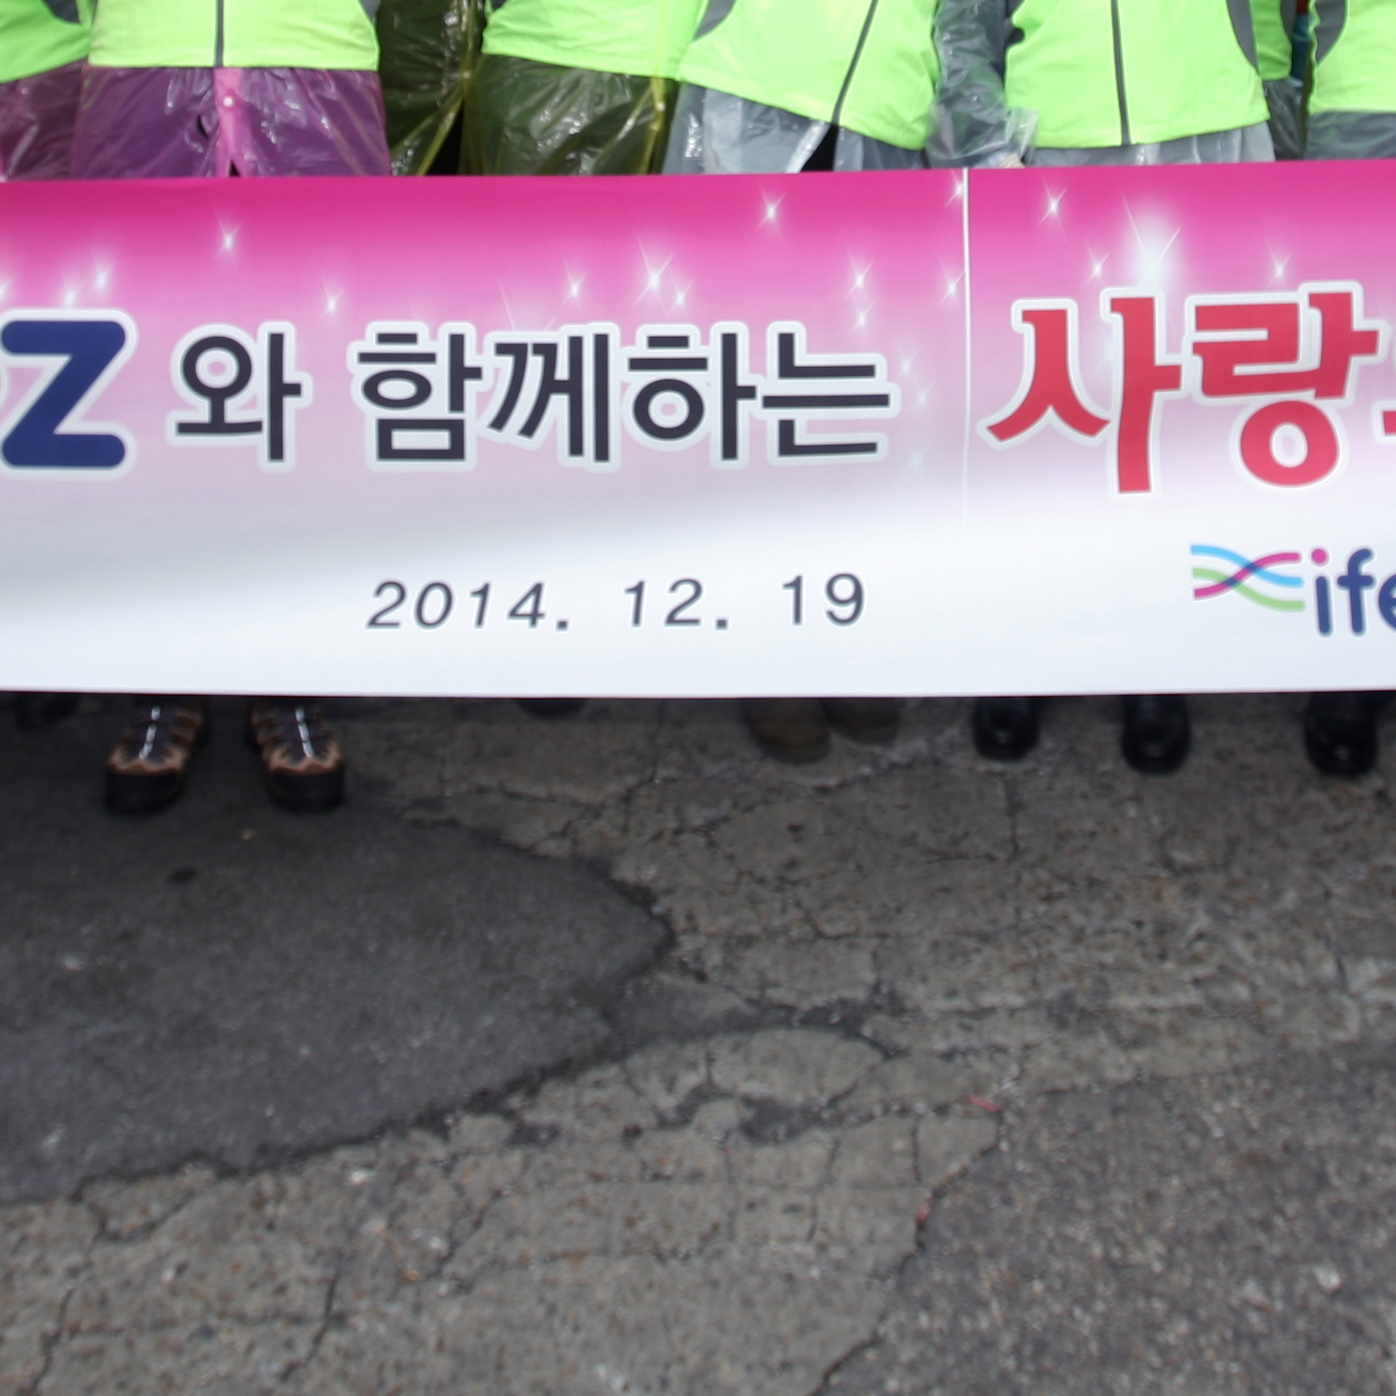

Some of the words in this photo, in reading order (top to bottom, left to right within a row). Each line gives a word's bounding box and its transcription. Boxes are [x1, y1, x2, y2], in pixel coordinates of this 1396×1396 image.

[174, 330, 304, 464] 와
[356, 330, 893, 465] 함께하는
[365, 577, 572, 631] 2014.
[620, 576, 730, 632] 12.
[780, 571, 867, 627] 19
